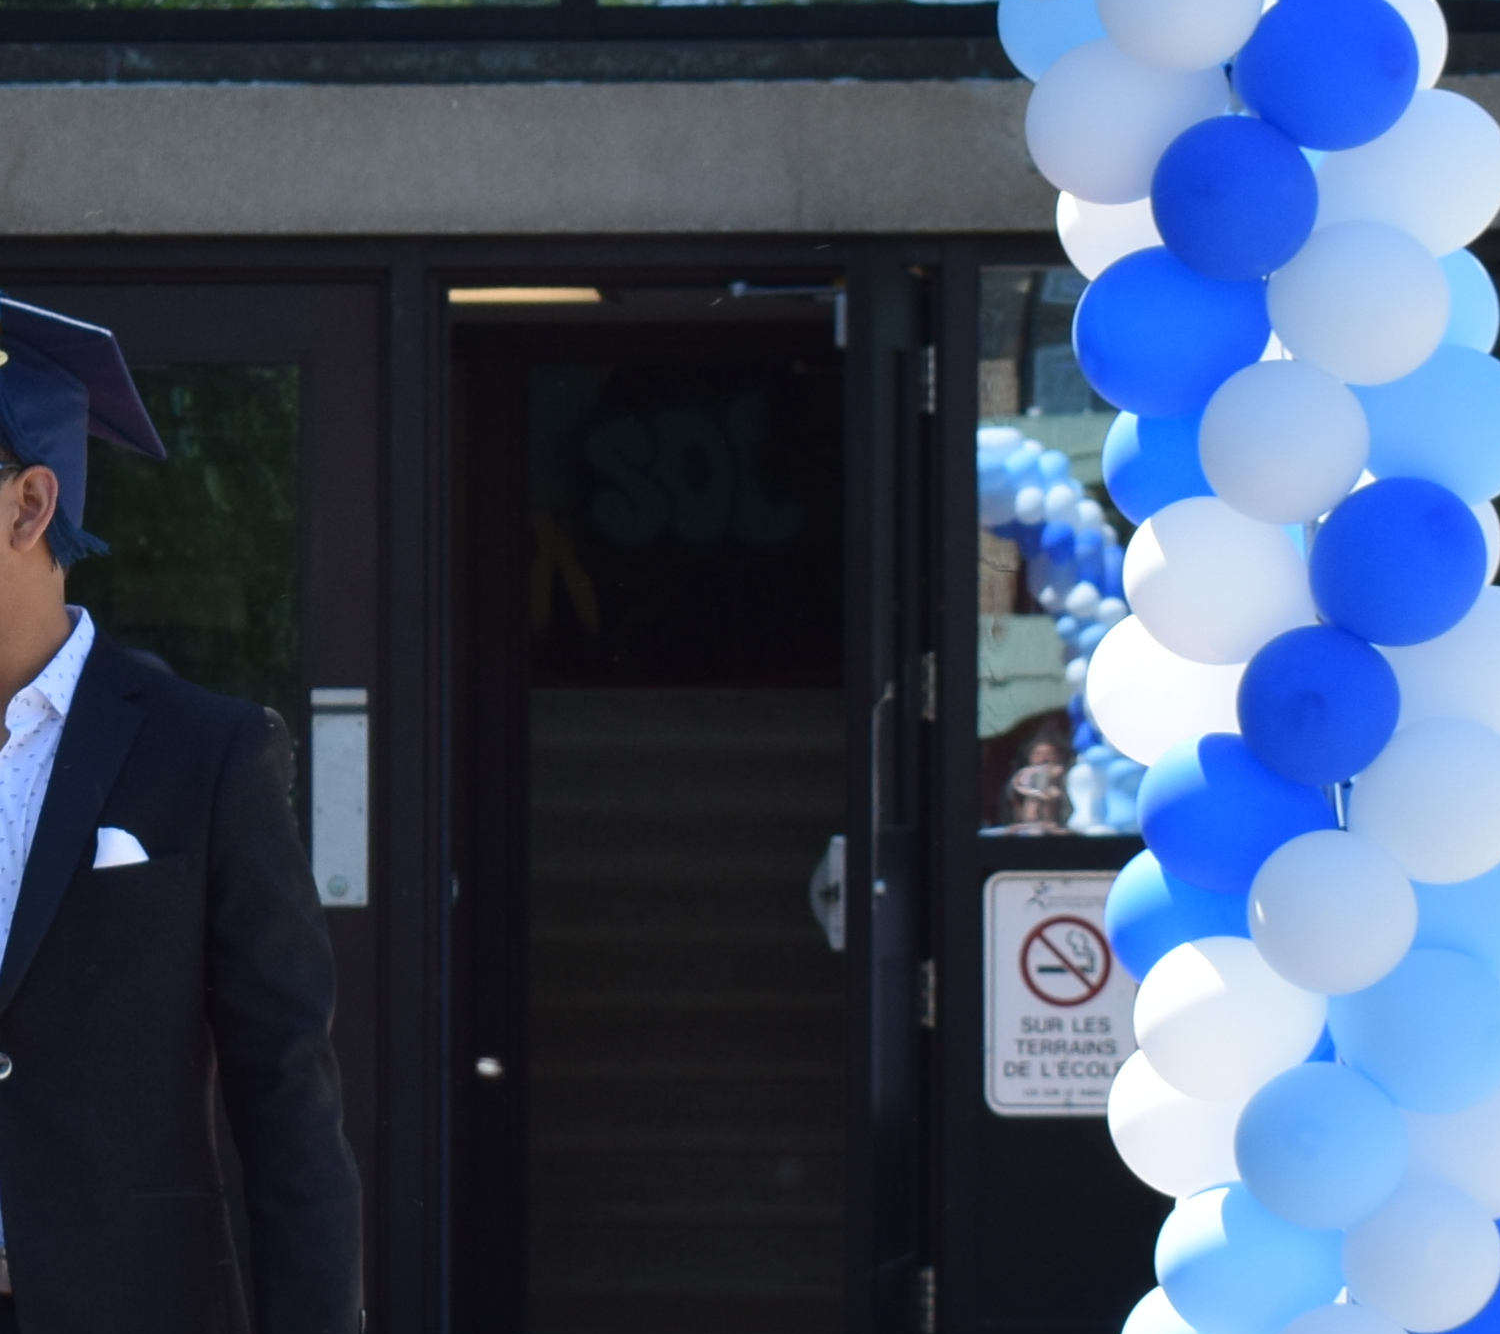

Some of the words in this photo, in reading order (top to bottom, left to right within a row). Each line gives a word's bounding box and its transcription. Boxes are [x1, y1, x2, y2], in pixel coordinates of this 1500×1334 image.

[1020, 1016, 1063, 1034] SUR
[1071, 1016, 1111, 1034] LES
[1015, 1038, 1117, 1055] TERRAINS
[1003, 1060, 1030, 1078] DE
